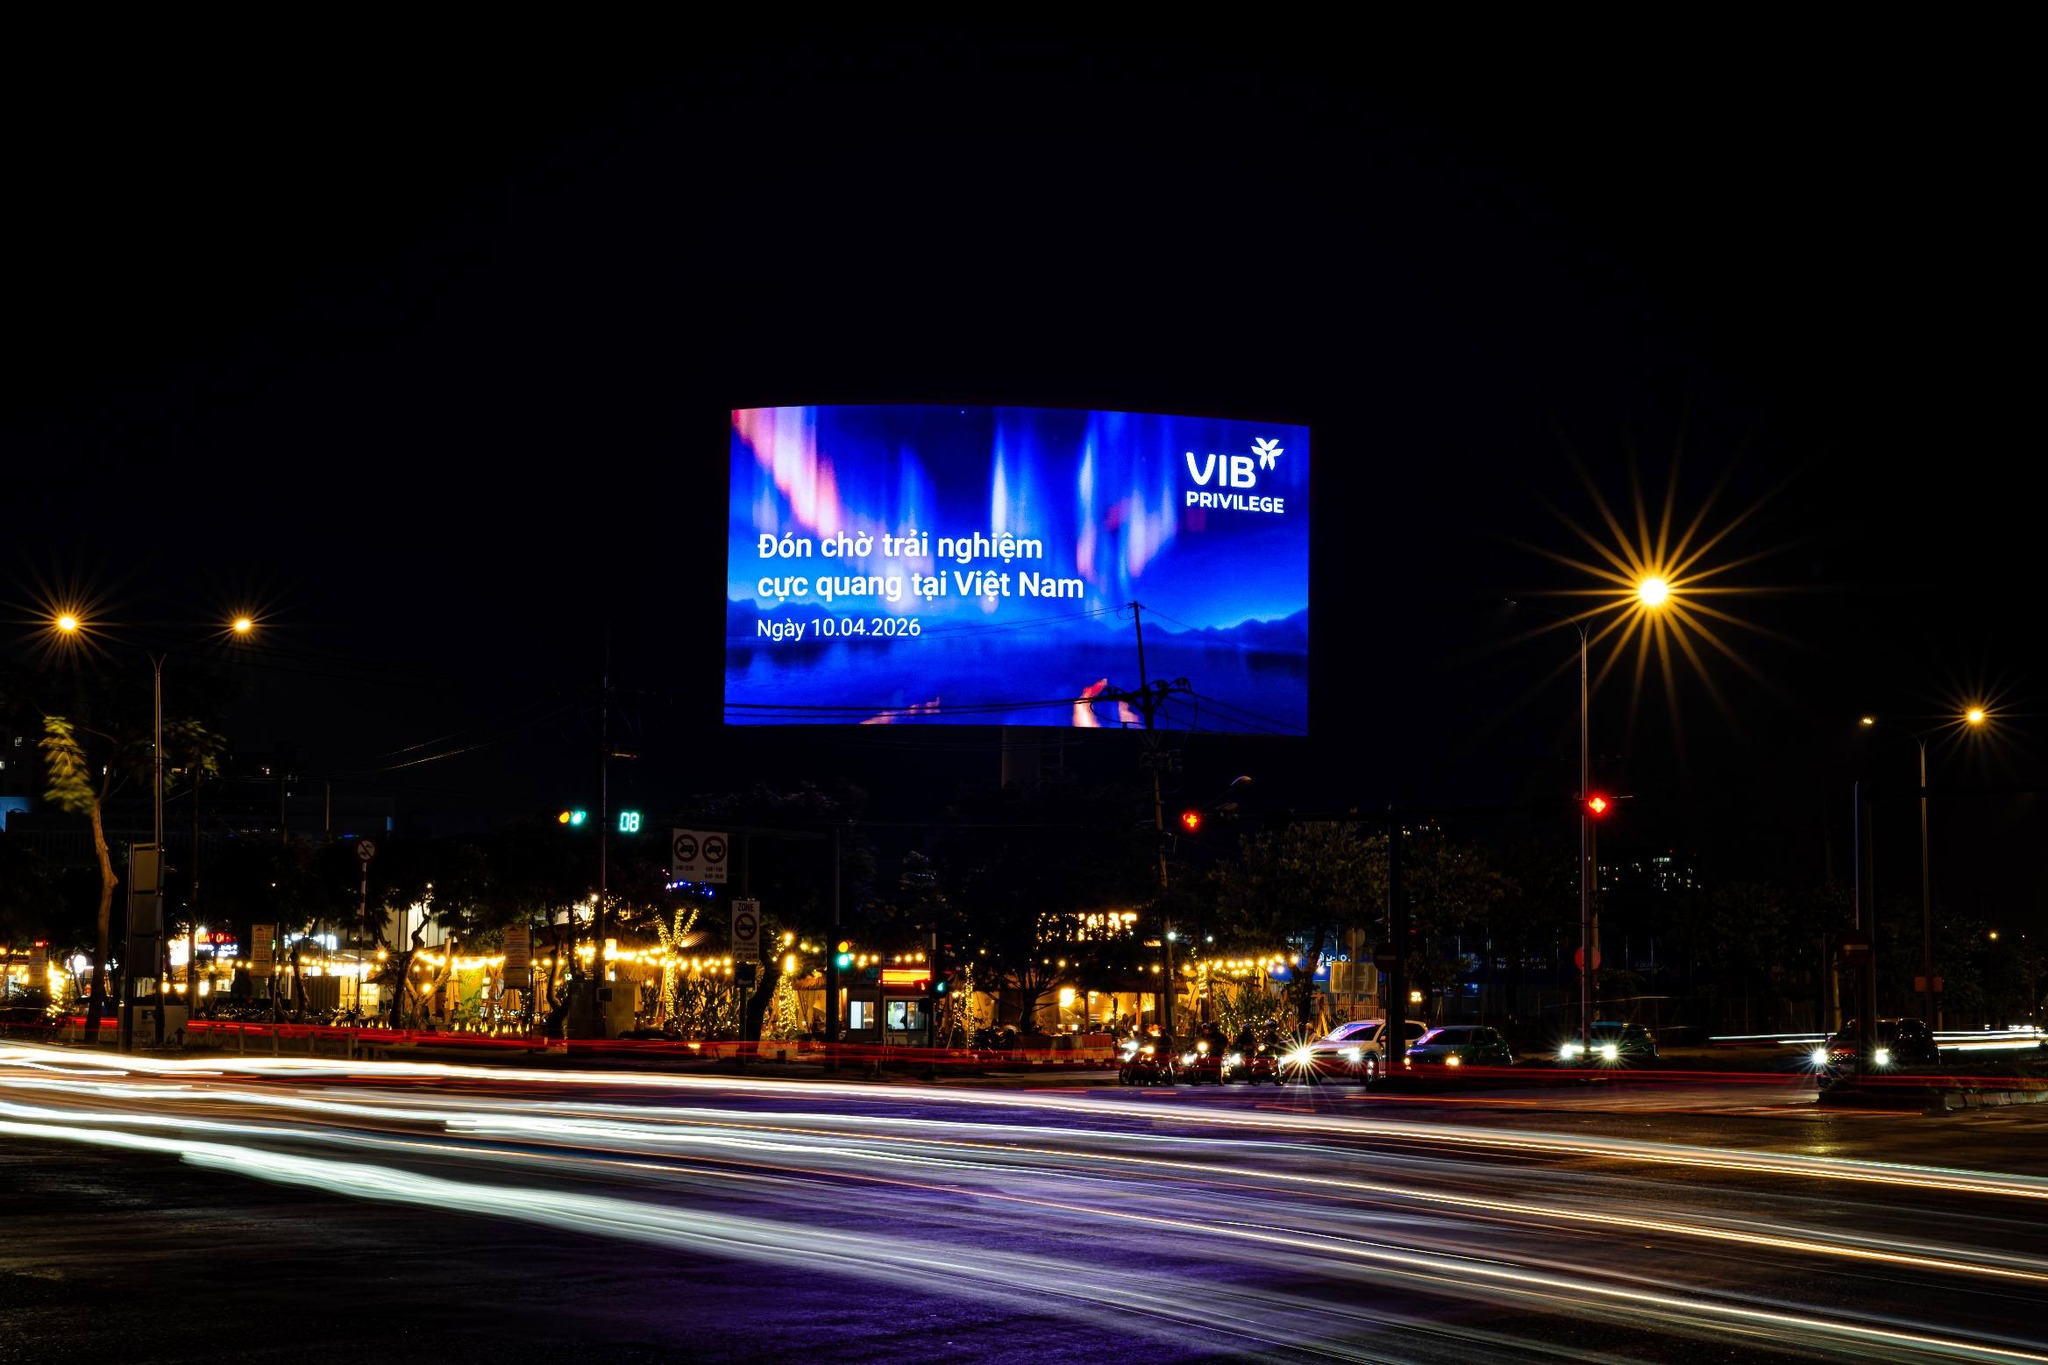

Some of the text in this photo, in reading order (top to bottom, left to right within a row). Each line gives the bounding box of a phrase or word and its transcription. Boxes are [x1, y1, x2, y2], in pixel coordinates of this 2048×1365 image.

[1185, 451, 1257, 489] VIB
[1186, 490, 1285, 514] PRIVILEGE
[757, 529, 1042, 564] Đón chờ trải nghiệm
[757, 570, 1084, 602] cực quang tại Việt Nam
[757, 617, 921, 642] Ngày 10.04.2026
[620, 812, 640, 832] 08
[737, 903, 755, 912] ZONE
